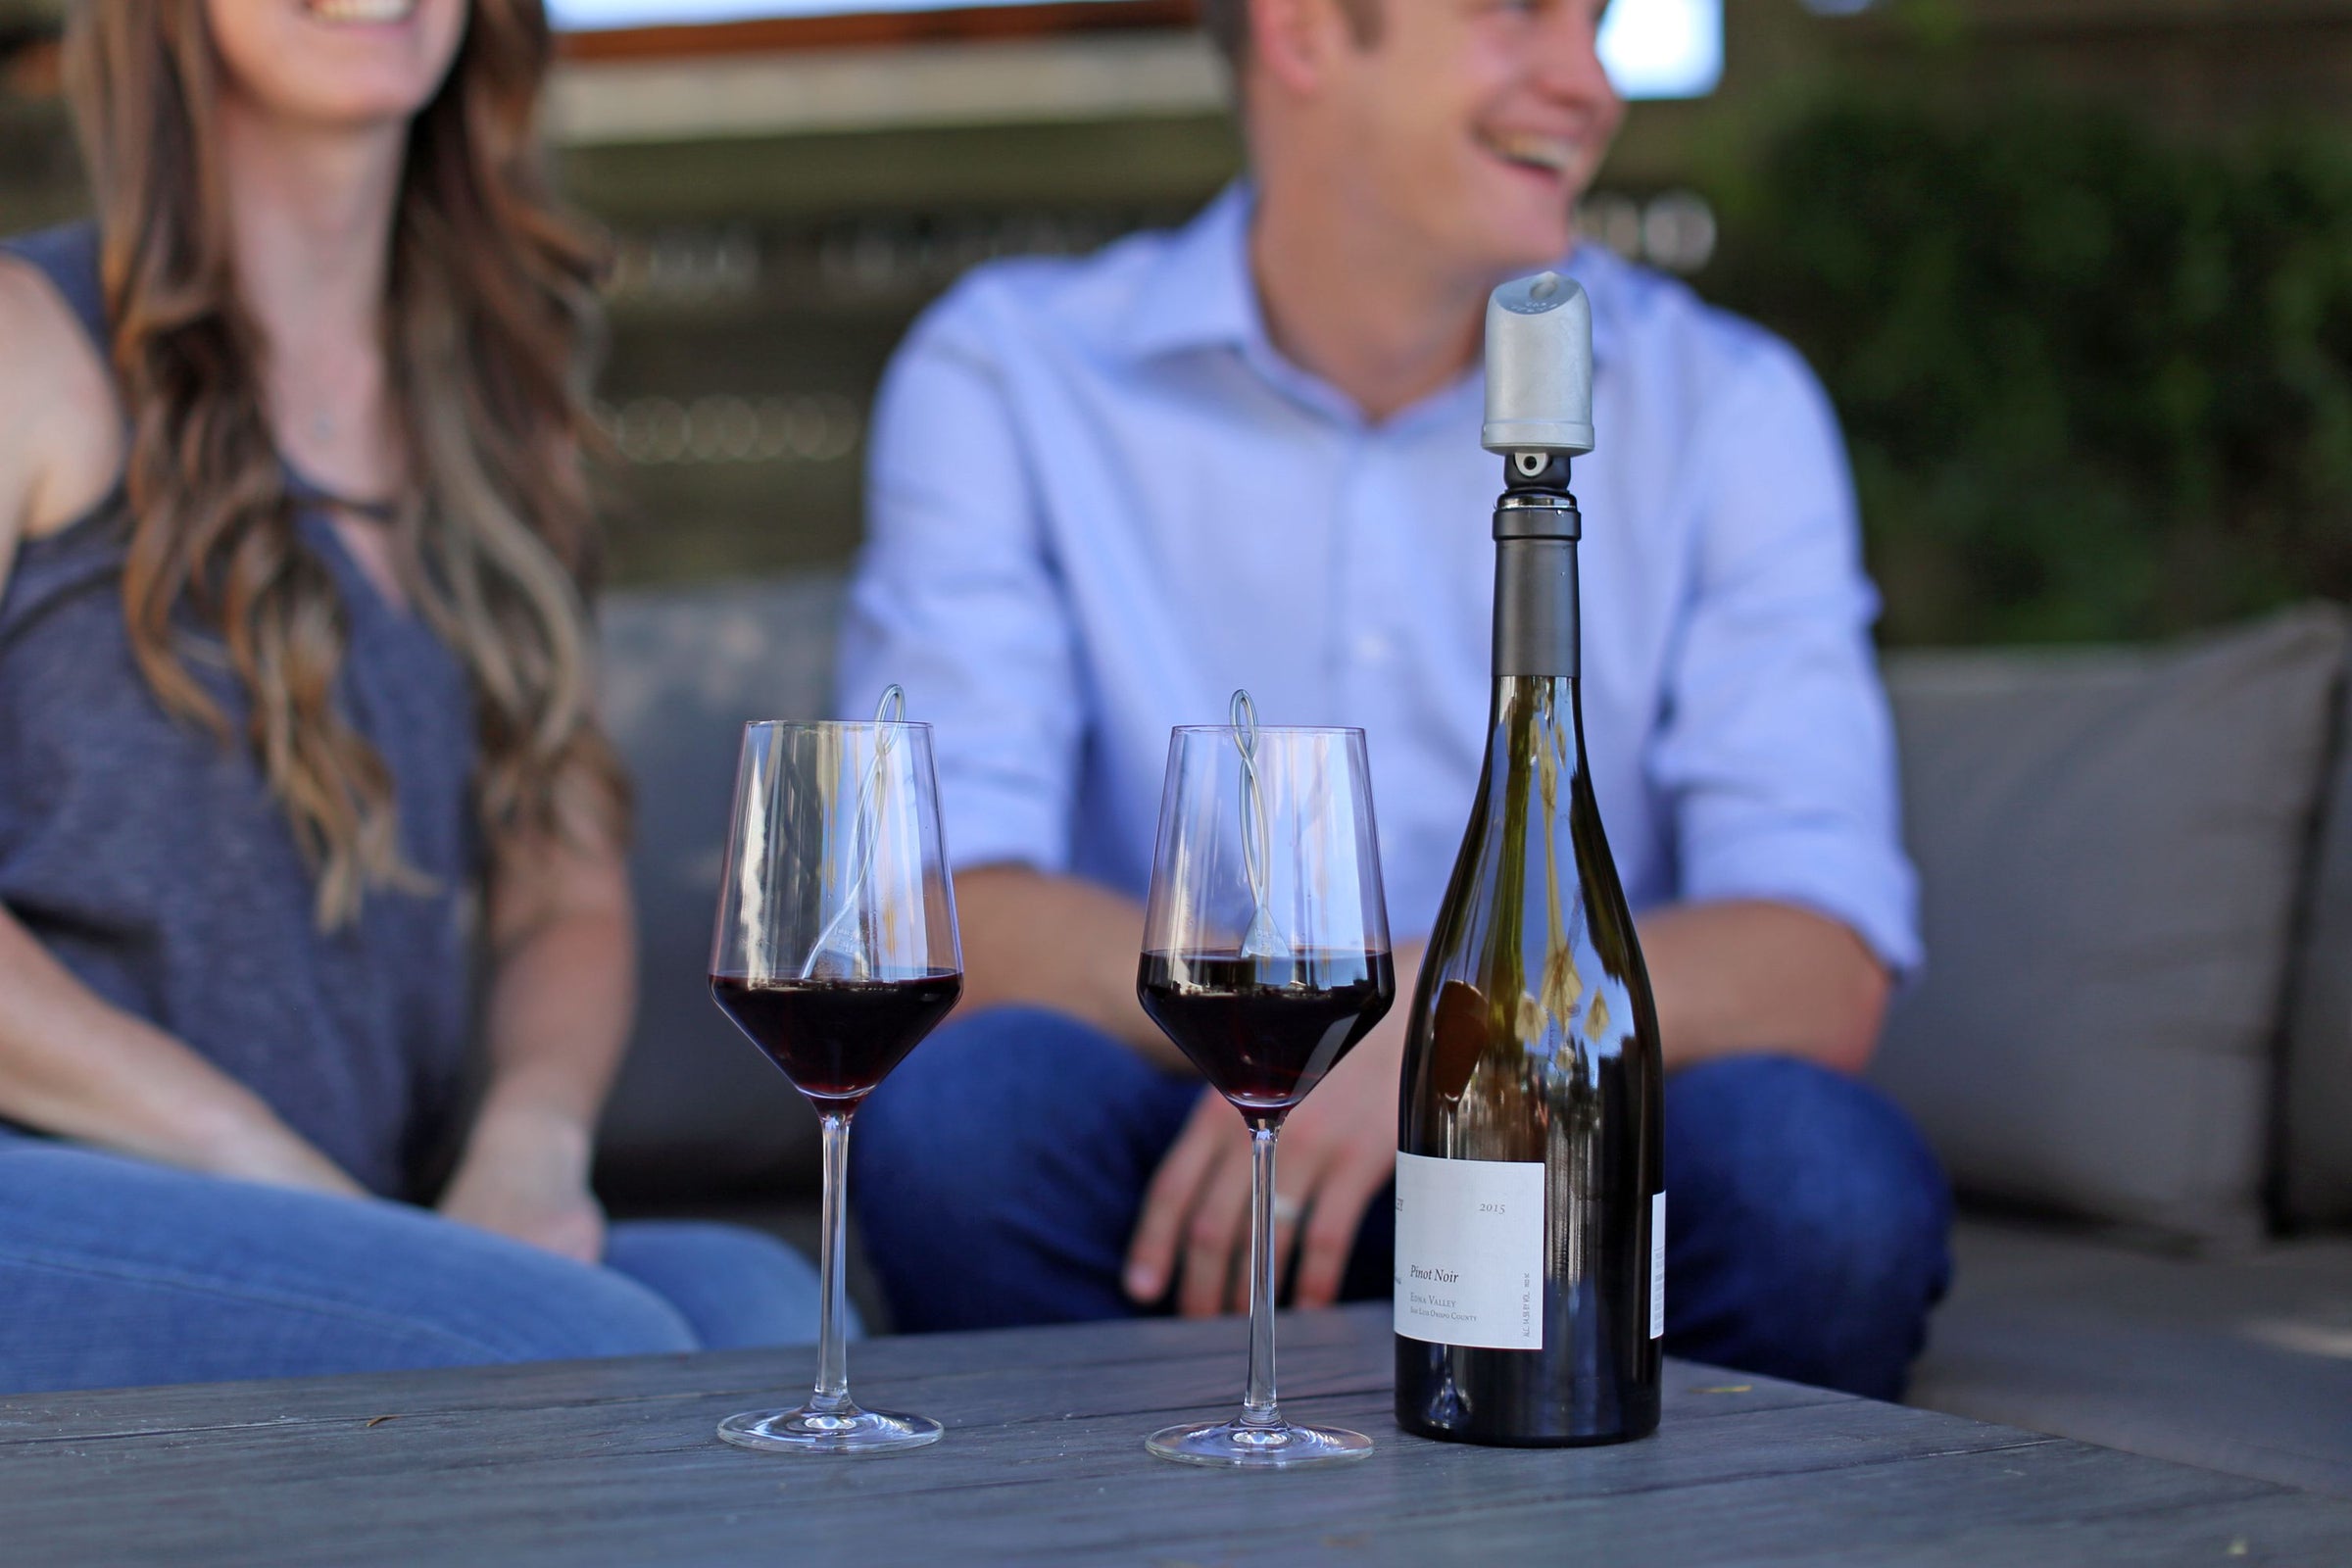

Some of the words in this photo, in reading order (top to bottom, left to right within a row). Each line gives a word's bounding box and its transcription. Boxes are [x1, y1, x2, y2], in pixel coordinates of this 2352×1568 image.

[1480, 1203, 1505, 1215] 2015
[1410, 1263, 1432, 1280] Pinot
[1434, 1268, 1459, 1284] Noir
